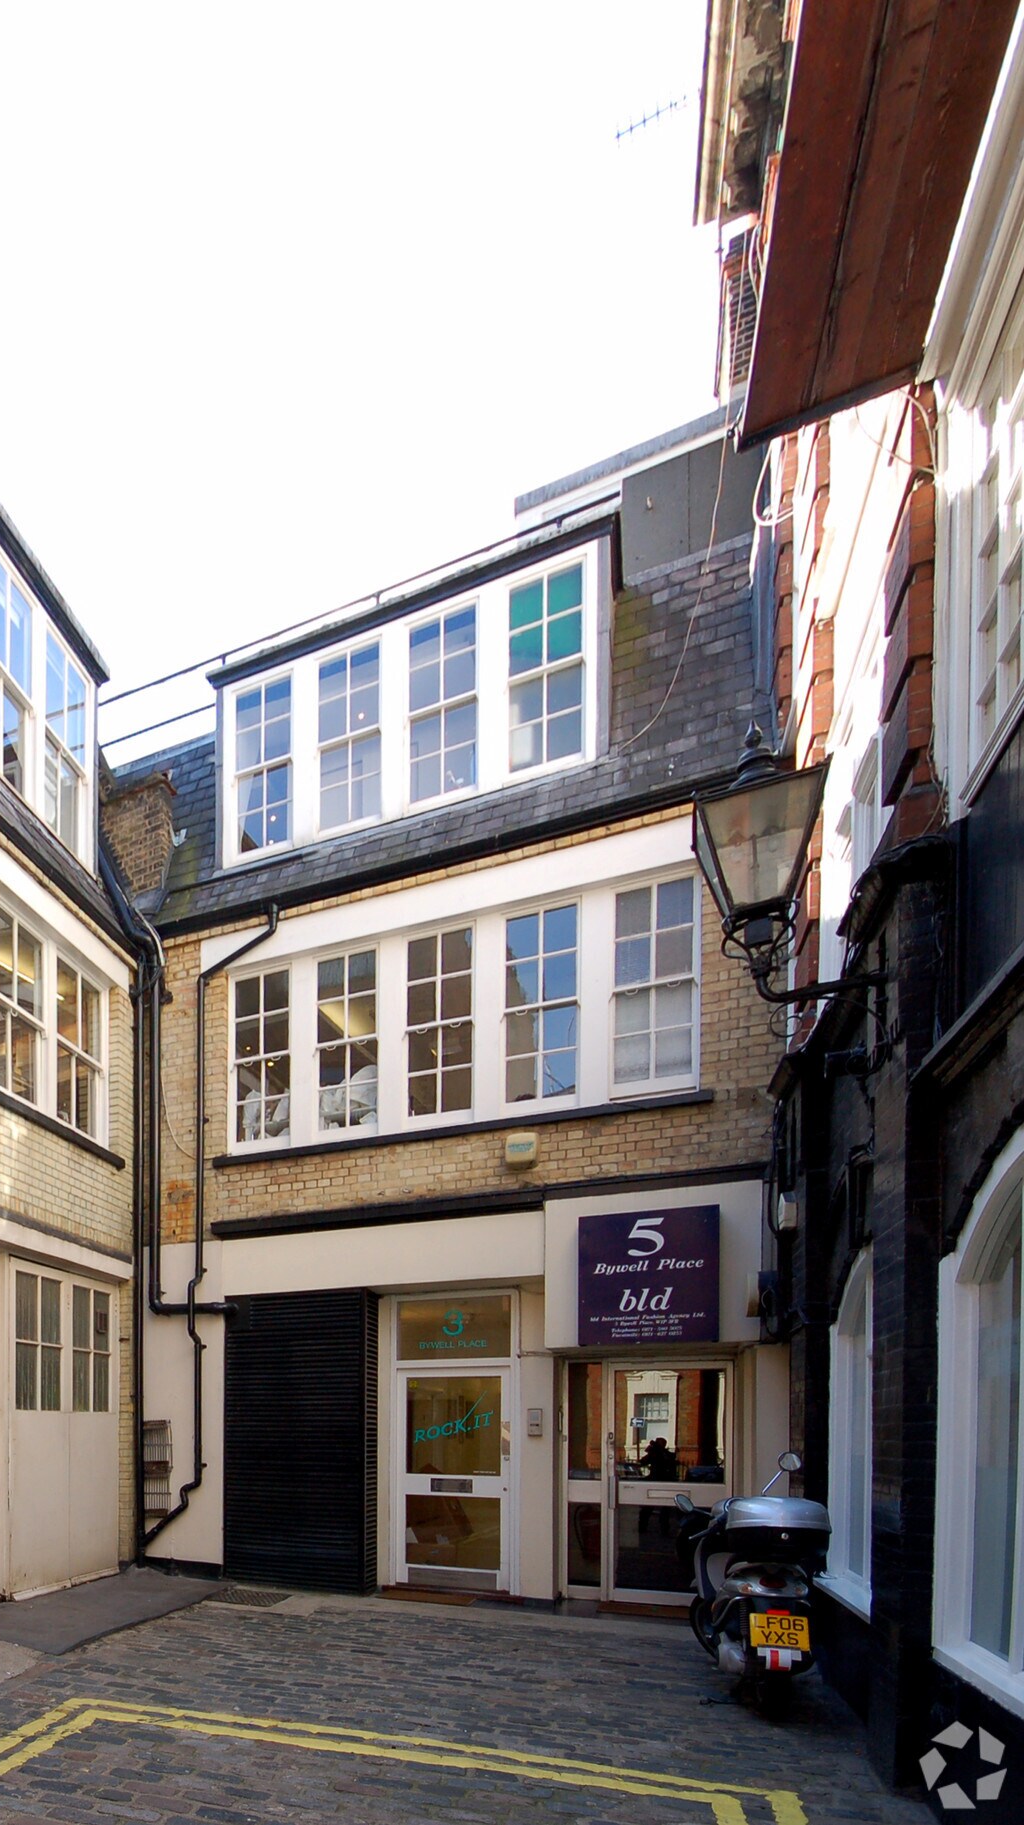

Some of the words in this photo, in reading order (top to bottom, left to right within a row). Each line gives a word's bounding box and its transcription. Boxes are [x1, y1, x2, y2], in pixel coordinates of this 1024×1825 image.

[628, 1217, 665, 1257] 5
[593, 1260, 649, 1275] Bywell
[656, 1258, 704, 1271] Place
[618, 1286, 674, 1312] bld
[442, 1308, 465, 1337] 3
[668, 1312, 690, 1320] Agency
[419, 1341, 455, 1349] BYWELL
[458, 1339, 487, 1348] PLACE
[754, 1616, 804, 1631] LF06
[761, 1630, 799, 1646] YXS
